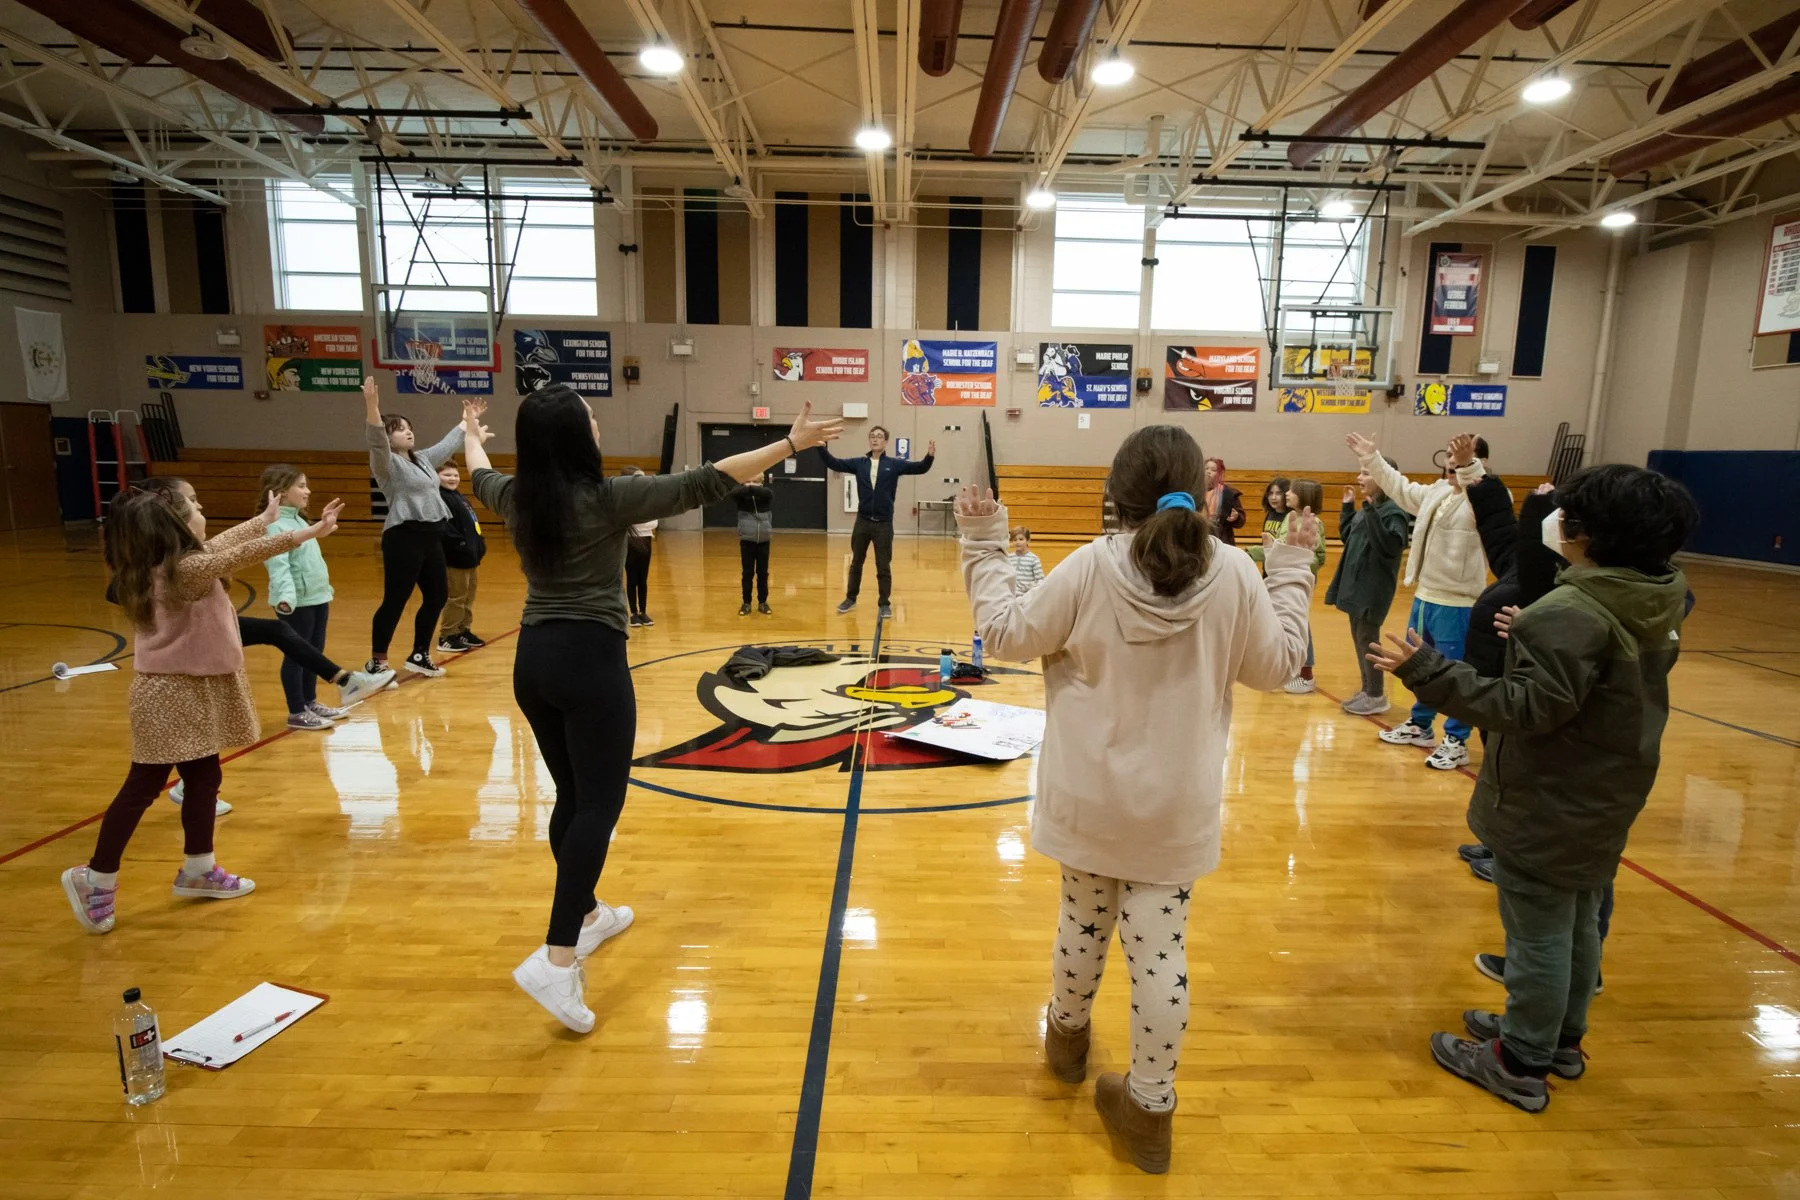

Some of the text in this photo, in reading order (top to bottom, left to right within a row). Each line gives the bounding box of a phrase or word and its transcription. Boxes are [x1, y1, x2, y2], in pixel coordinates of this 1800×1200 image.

[466, 337, 488, 345] SCHOOL
[563, 340, 608, 348] LEXINGTON SCHOOL
[457, 347, 488, 355] FOR THE DEAF
[943, 359, 993, 367] SCHOOL FOR THE DEAF
[816, 366, 865, 375] SCHOOL FOR THE DEAF
[312, 377, 360, 385] SCHOOL FOR THE DEAF
[578, 382, 587, 390] FOR
[588, 382, 597, 390] THE
[597, 382, 608, 390] DEAF
[1235, 386, 1253, 394] SCHOOL
[756, 408, 767, 417] EXIT
